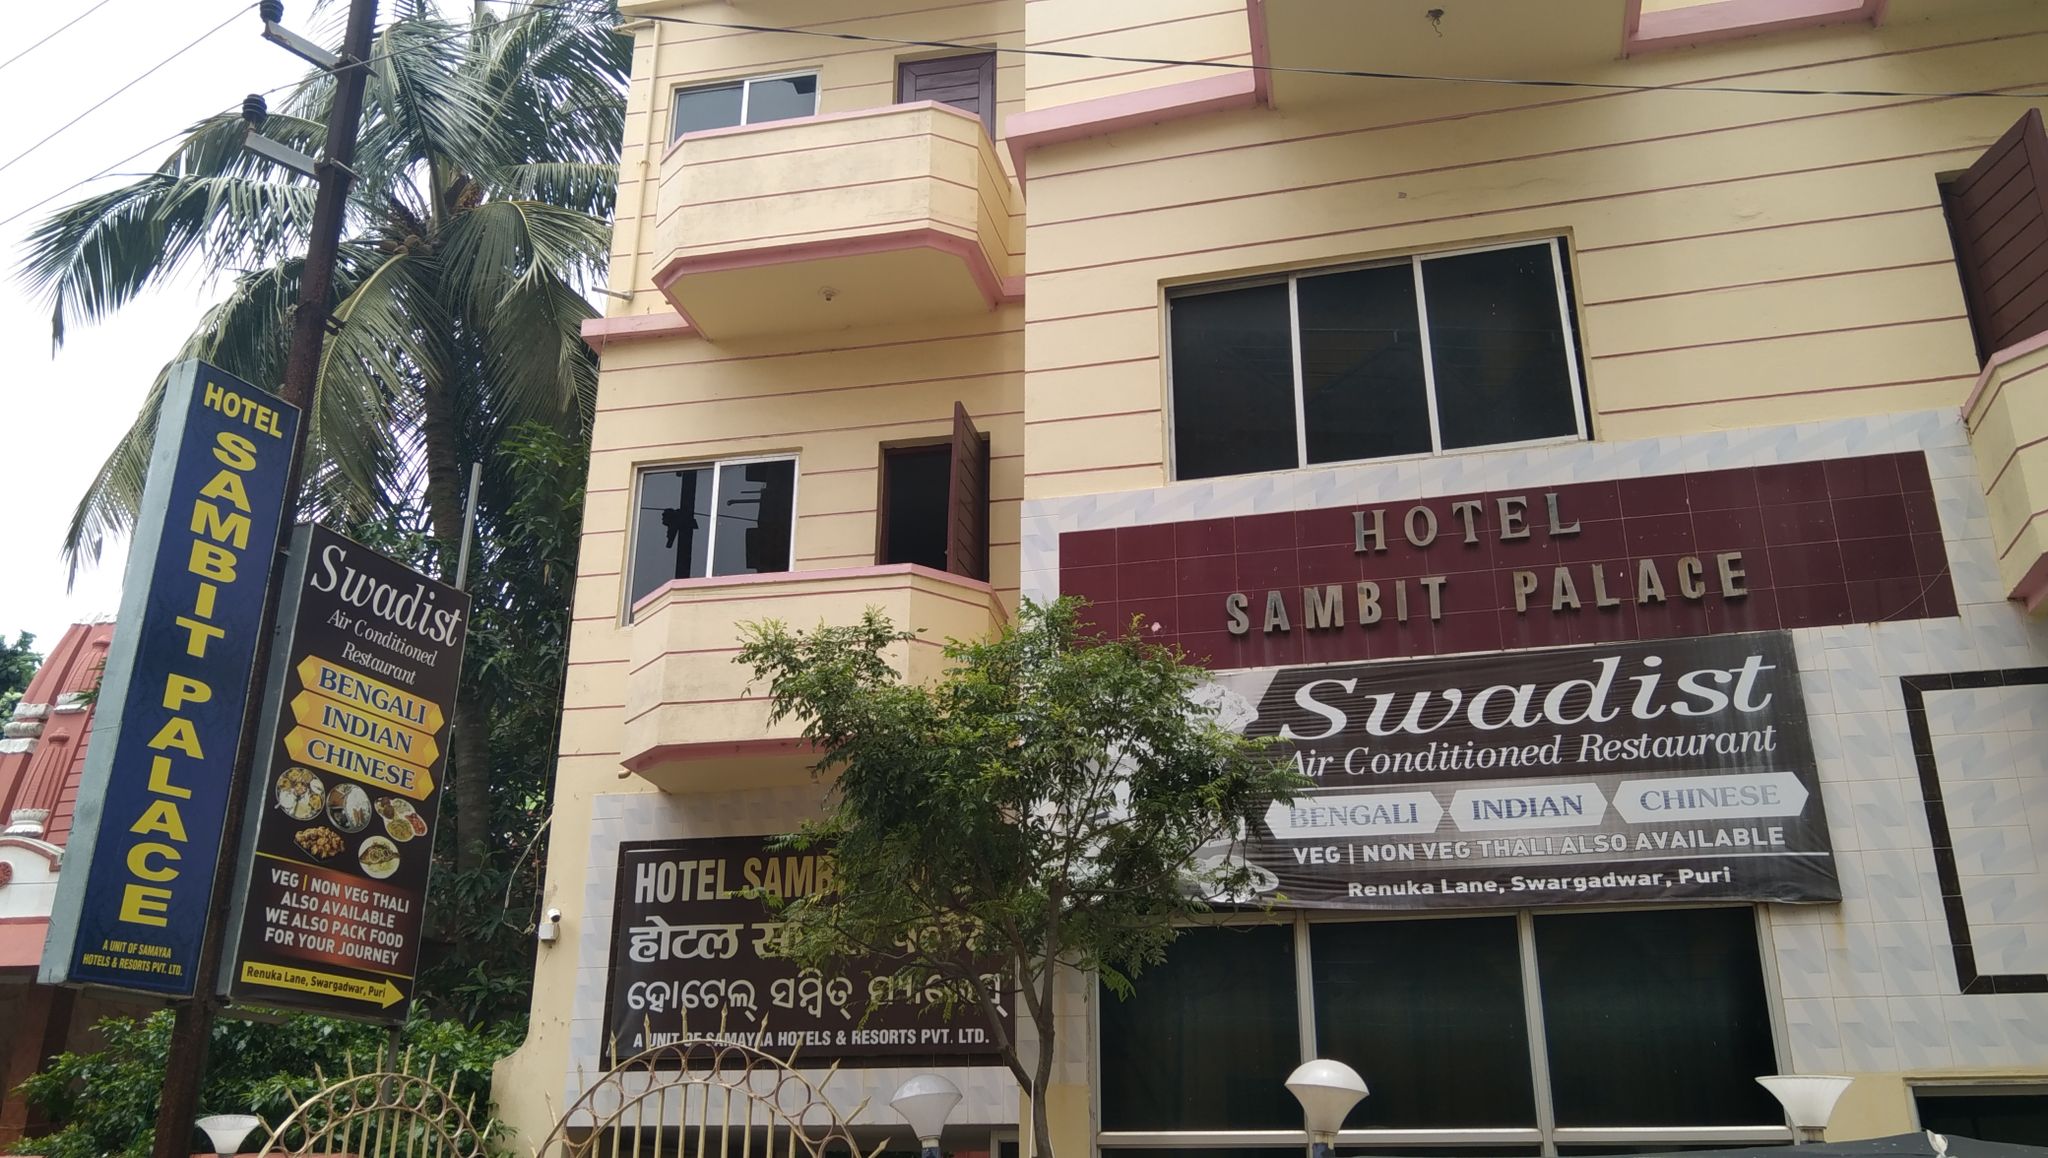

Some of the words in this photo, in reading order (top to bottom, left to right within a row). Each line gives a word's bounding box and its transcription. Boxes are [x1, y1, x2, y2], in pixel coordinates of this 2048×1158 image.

[204, 382, 283, 438] HOTEL
[176, 431, 257, 658] SAMBIT
[1352, 493, 1581, 552] HOTEL
[310, 545, 462, 647] Swadist
[1225, 576, 1447, 635] SAMBIT
[1512, 551, 1748, 613] PALACE
[327, 609, 352, 631] Air
[354, 619, 438, 667] Conditioned
[341, 642, 416, 685] Restaurant
[318, 666, 426, 725] BENGALI
[1278, 655, 1776, 740] Swadist
[322, 705, 413, 754] INDIAN
[1285, 750, 1334, 777] Air
[1344, 734, 1563, 776] Conditioned
[1576, 725, 1777, 763] Restaurant
[307, 739, 416, 790] CHINESE
[119, 673, 212, 928] PALACE
[1290, 803, 1419, 829] BENGALI
[1471, 794, 1583, 821] INDIAN
[1639, 784, 1781, 811] CHINESE
[1292, 847, 1341, 865] VEG
[1363, 843, 1415, 862] NON
[1420, 841, 1471, 860] VEG
[1476, 837, 1551, 859] THALI
[1560, 834, 1627, 856] ALSO
[1634, 826, 1785, 851] AVAILABLE
[271, 868, 299, 888] VEG
[311, 878, 340, 897] NON
[344, 885, 369, 904] VEG
[372, 892, 410, 914] THALI
[634, 859, 731, 904] HOTEL
[742, 855, 848, 901] SAMB
[1348, 879, 1434, 897] Renuka
[1441, 879, 1505, 895] Lane,
[1511, 872, 1672, 892] Swargadwar,
[1678, 866, 1731, 884] Puri
[265, 907, 289, 925] WE
[291, 913, 328, 933] ALSO
[332, 921, 366, 941] PACK
[369, 930, 404, 948] FOOD
[281, 891, 319, 911] ALSO
[321, 901, 396, 928] AVAILABLE
[102, 939, 109, 951] A
[109, 940, 127, 953] UNIT
[127, 943, 138, 954] OF
[138, 944, 172, 959] SAMAYAA
[265, 927, 294, 946] FOR
[299, 933, 336, 953] YOUR
[338, 943, 399, 966] JOURNEY
[629, 915, 744, 963] होटल
[82, 953, 111, 967] HOTELS
[111, 957, 118, 968] &
[119, 958, 151, 972] RESORTS
[151, 962, 167, 974] PVT.
[168, 964, 183, 976] LTD.
[246, 966, 282, 981] Renuka
[284, 972, 308, 987] Lane,
[310, 976, 366, 996] Swargadwar,
[368, 986, 385, 998] Puri
[633, 1033, 643, 1048] A
[649, 1032, 680, 1047] UNIT
[778, 1030, 831, 1047] HOTELS
[836, 1031, 847, 1046] &
[852, 1029, 916, 1045] RESORTS
[921, 1028, 953, 1044] PVT.
[958, 1028, 990, 1044] LTD.
